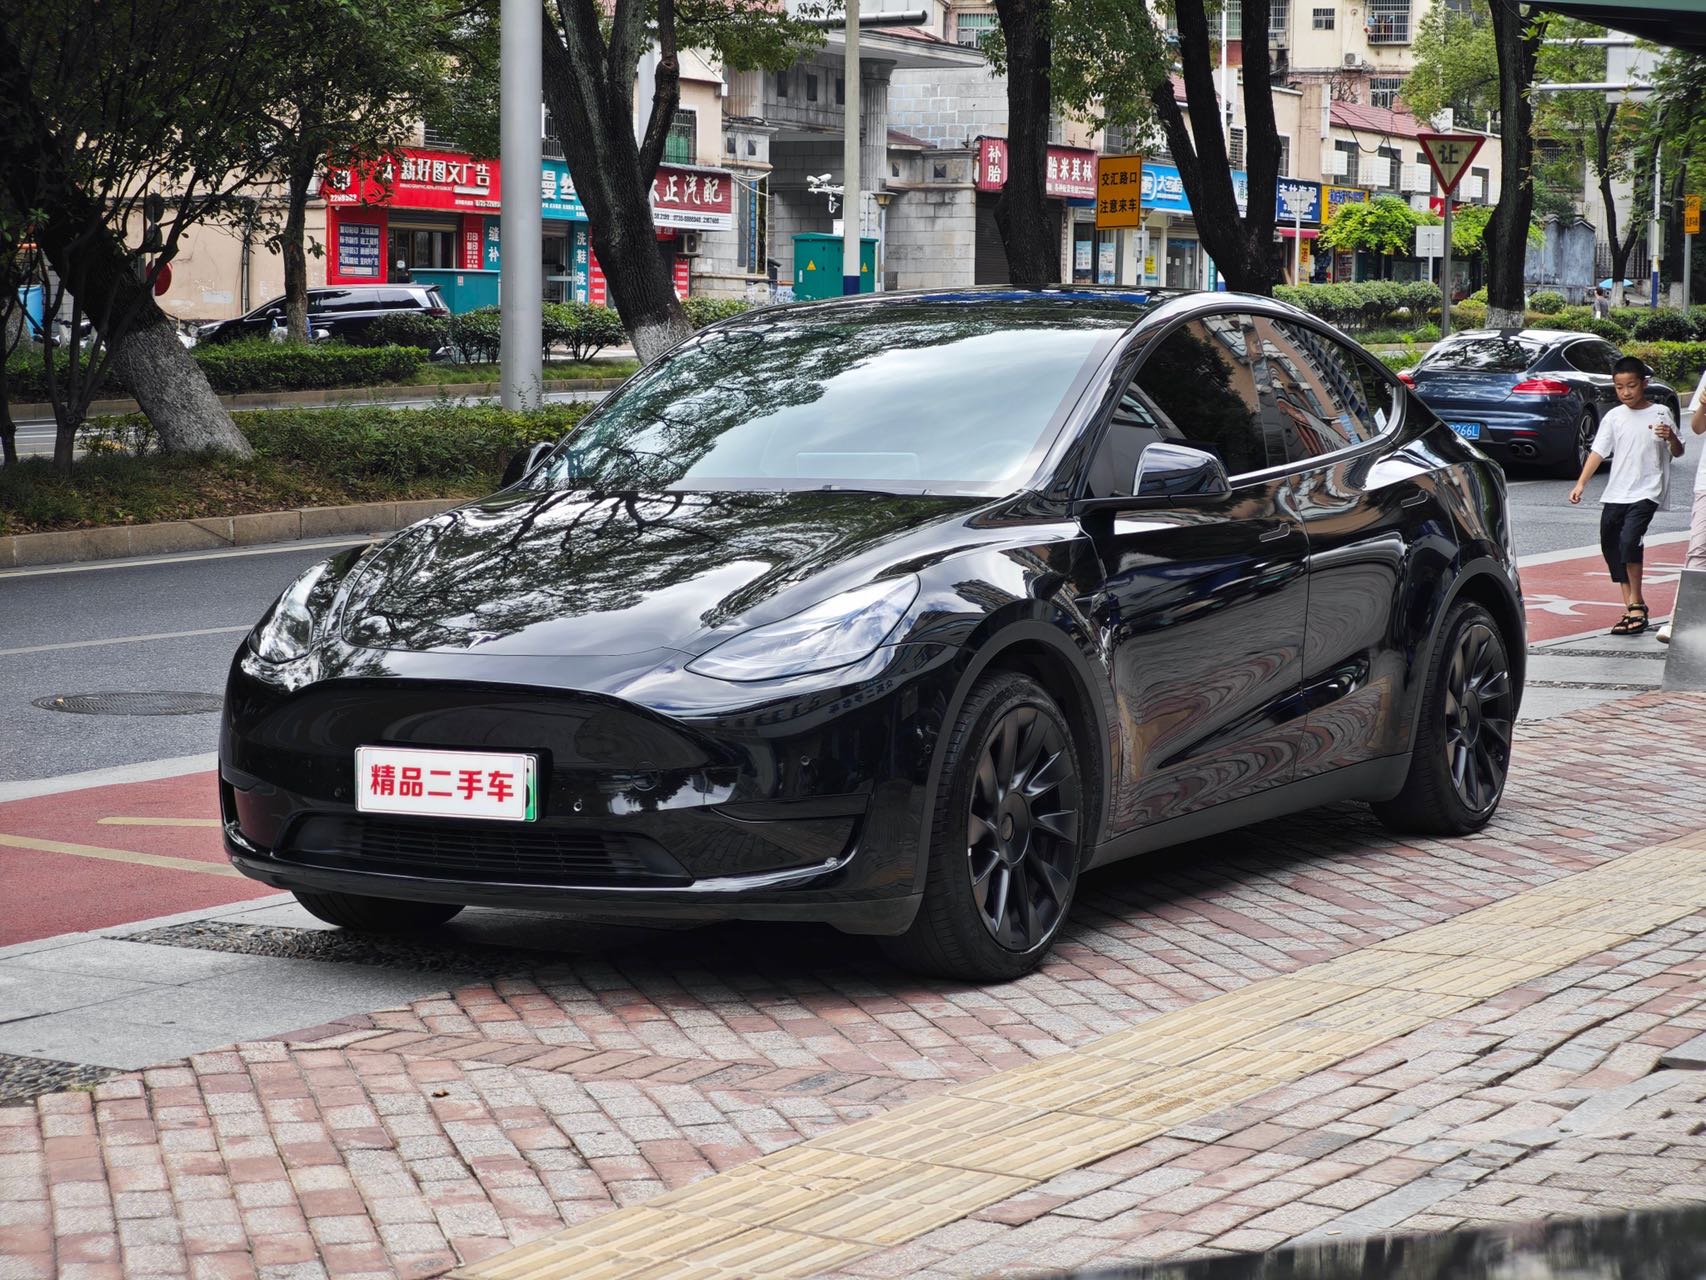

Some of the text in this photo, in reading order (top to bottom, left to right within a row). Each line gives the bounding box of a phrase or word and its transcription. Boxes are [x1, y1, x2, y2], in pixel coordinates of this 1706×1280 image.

[988, 145, 1001, 182] 补胎
[1439, 144, 1459, 164] 让
[401, 157, 490, 185] 新好图文广告
[1048, 156, 1092, 181] 胎米其林
[1102, 171, 1137, 186] 交汇路口
[1100, 198, 1137, 214] 注意来车
[488, 226, 500, 262] 缝补
[370, 764, 514, 802] 精品二手车
